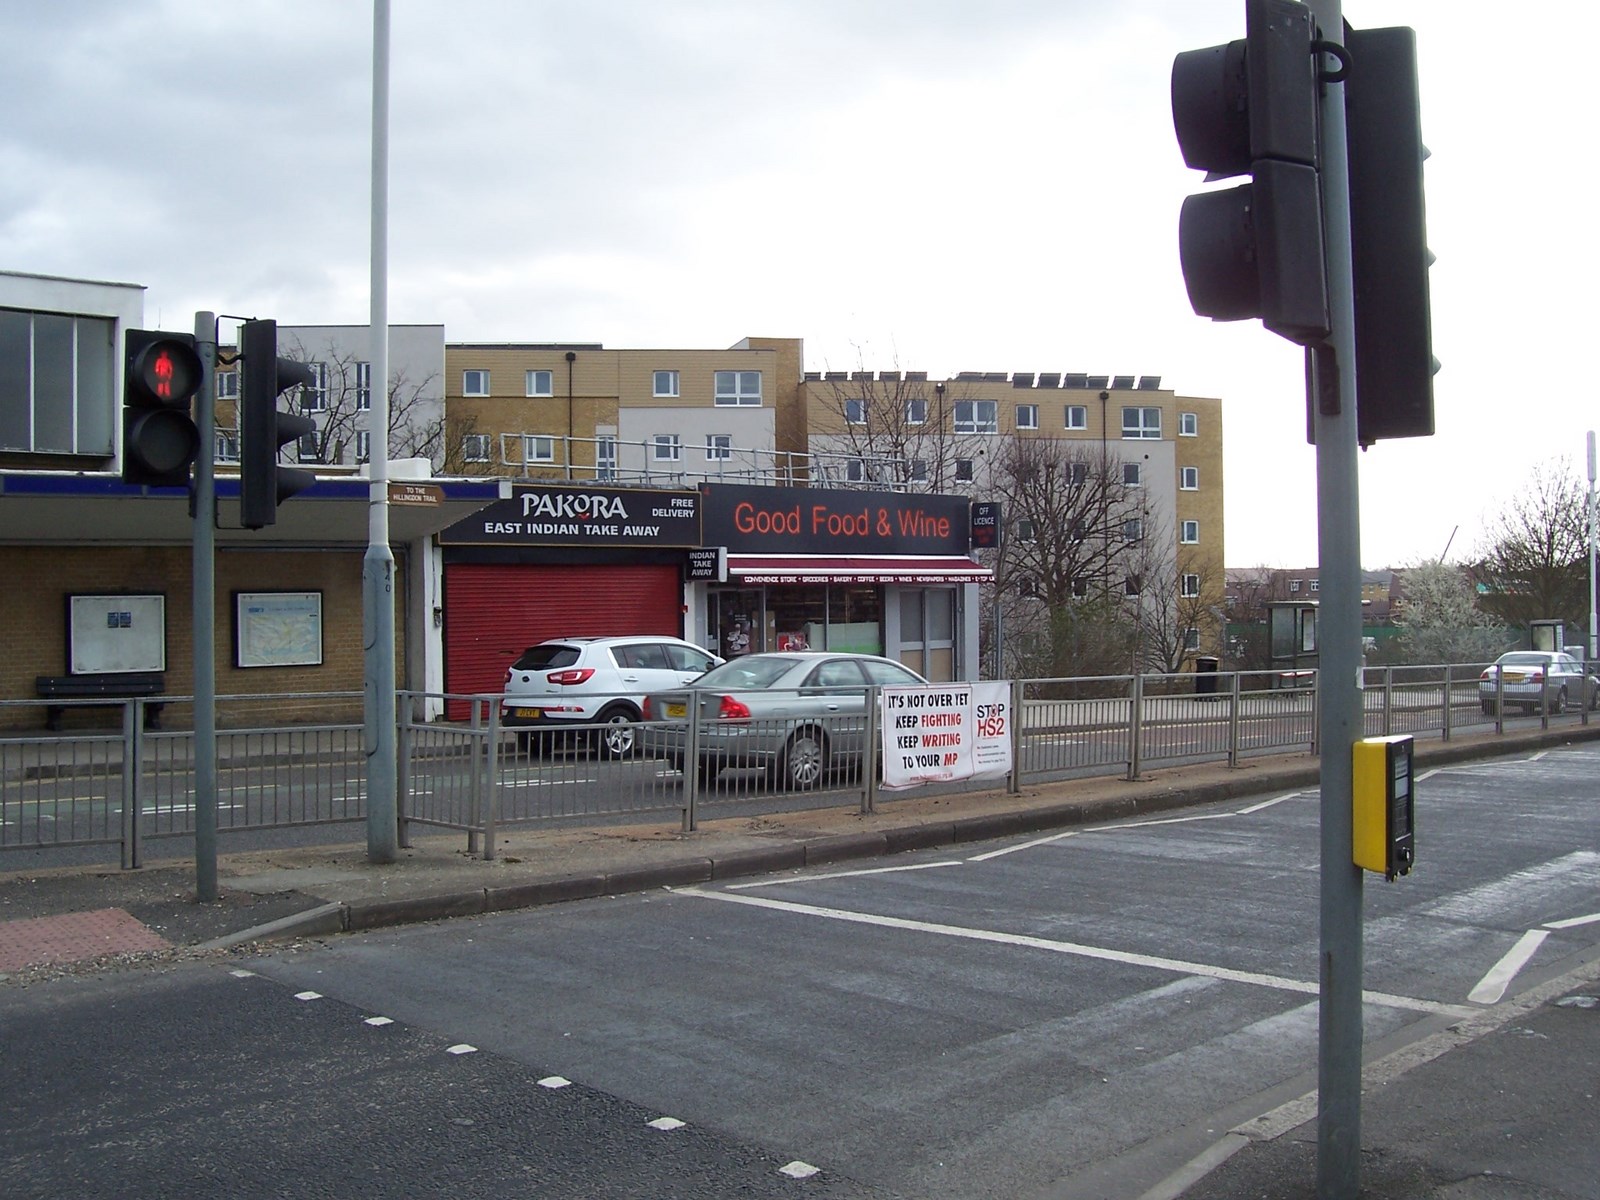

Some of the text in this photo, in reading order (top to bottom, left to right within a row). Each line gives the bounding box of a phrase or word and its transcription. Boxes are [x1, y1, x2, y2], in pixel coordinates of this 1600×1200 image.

[393, 494, 422, 502] HILLINGDON
[671, 498, 694, 507] FREE
[520, 493, 629, 519] PAKORA
[652, 508, 695, 518] DELIVERY
[979, 506, 989, 515] OFF
[735, 502, 801, 534] Good
[812, 506, 868, 536] Food
[876, 508, 892, 537] &
[898, 509, 950, 538] Wine
[974, 516, 994, 526] LICENCE
[484, 522, 660, 537] EAST INDIAN TAKE AWAY
[689, 552, 716, 560] INDIAN
[693, 560, 712, 568] TAKE
[888, 693, 968, 709] IT'S NOT OVER YET
[977, 703, 1005, 719] STOP
[896, 713, 962, 729] KEEP FIGHTING
[977, 717, 1005, 737] HS2
[897, 735, 919, 749] KEEP
[922, 733, 961, 748] WRITING
[902, 752, 958, 770] TO YOUR MP
